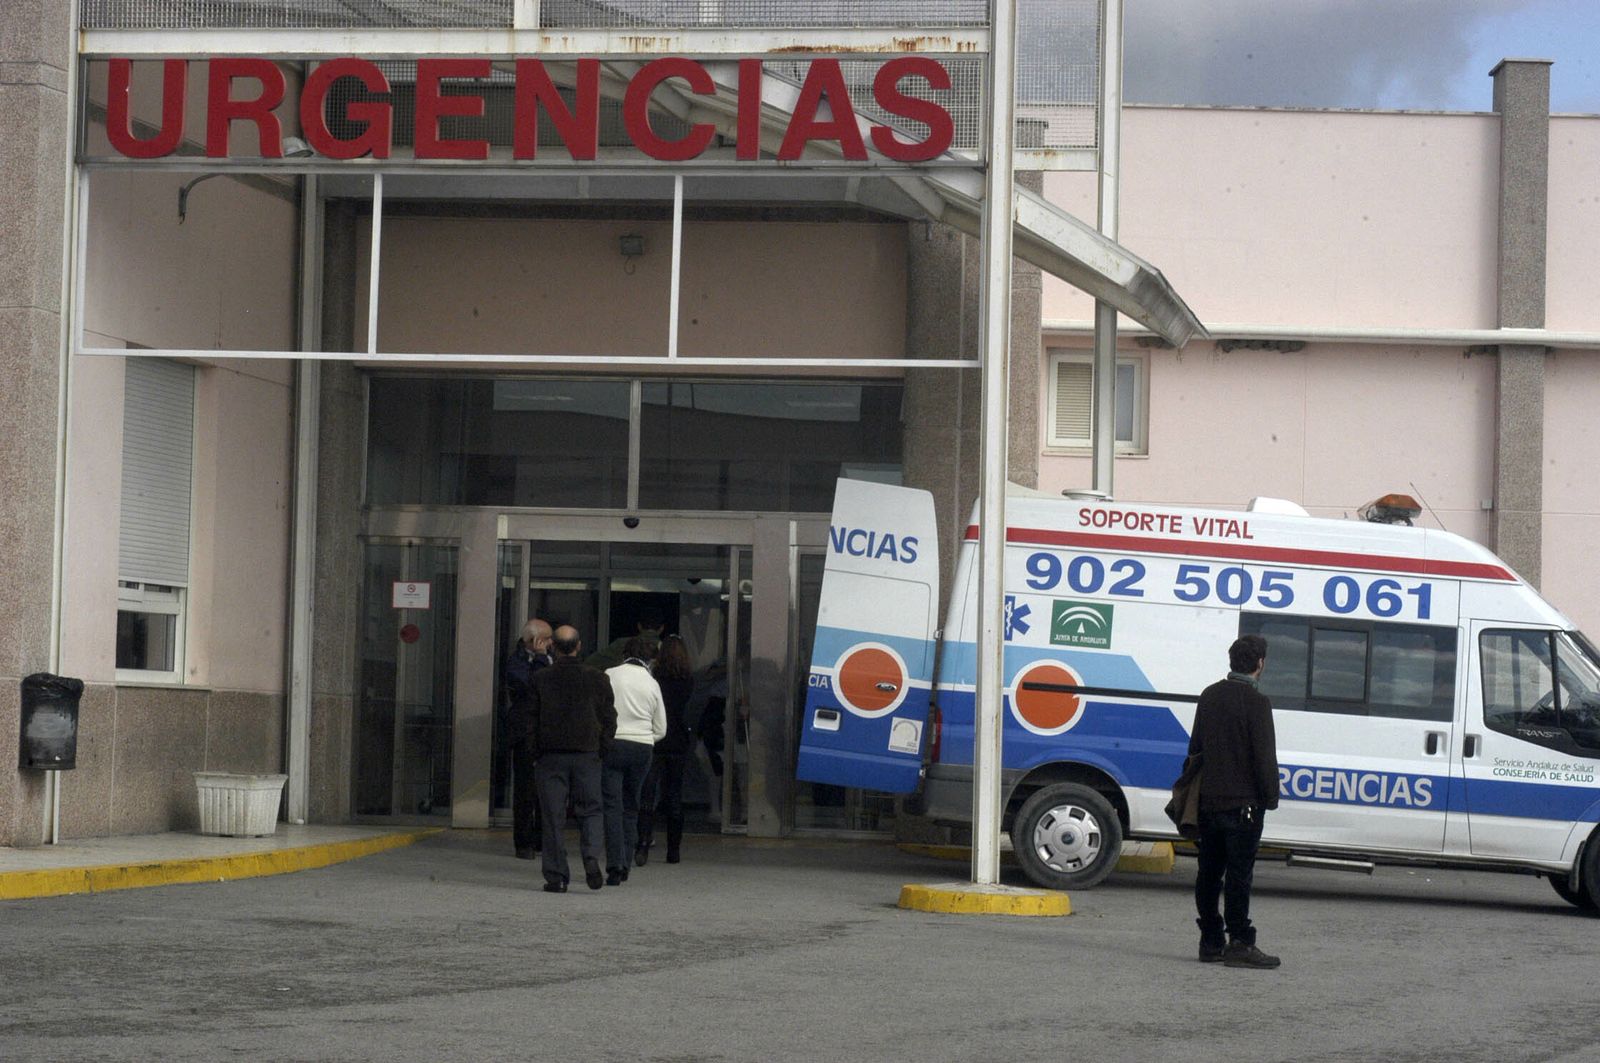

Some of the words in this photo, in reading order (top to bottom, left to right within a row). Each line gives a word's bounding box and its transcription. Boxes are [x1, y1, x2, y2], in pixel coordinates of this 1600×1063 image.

[106, 56, 955, 163] URGENCIAS
[1078, 508, 1183, 533] SOPORTE
[1193, 517, 1254, 539] VITAL
[1025, 552, 1146, 598] 902
[1173, 564, 1295, 609] 505
[1322, 575, 1432, 620] 061
[808, 674, 829, 689] CIA
[1517, 728, 1561, 738] TRANST
[1494, 757, 1524, 768] Servicio
[1526, 760, 1558, 771] Andaluz
[1561, 763, 1571, 771] de
[1573, 763, 1594, 773] Salud
[1549, 772, 1562, 781] DE
[1564, 774, 1594, 783] SALUD
